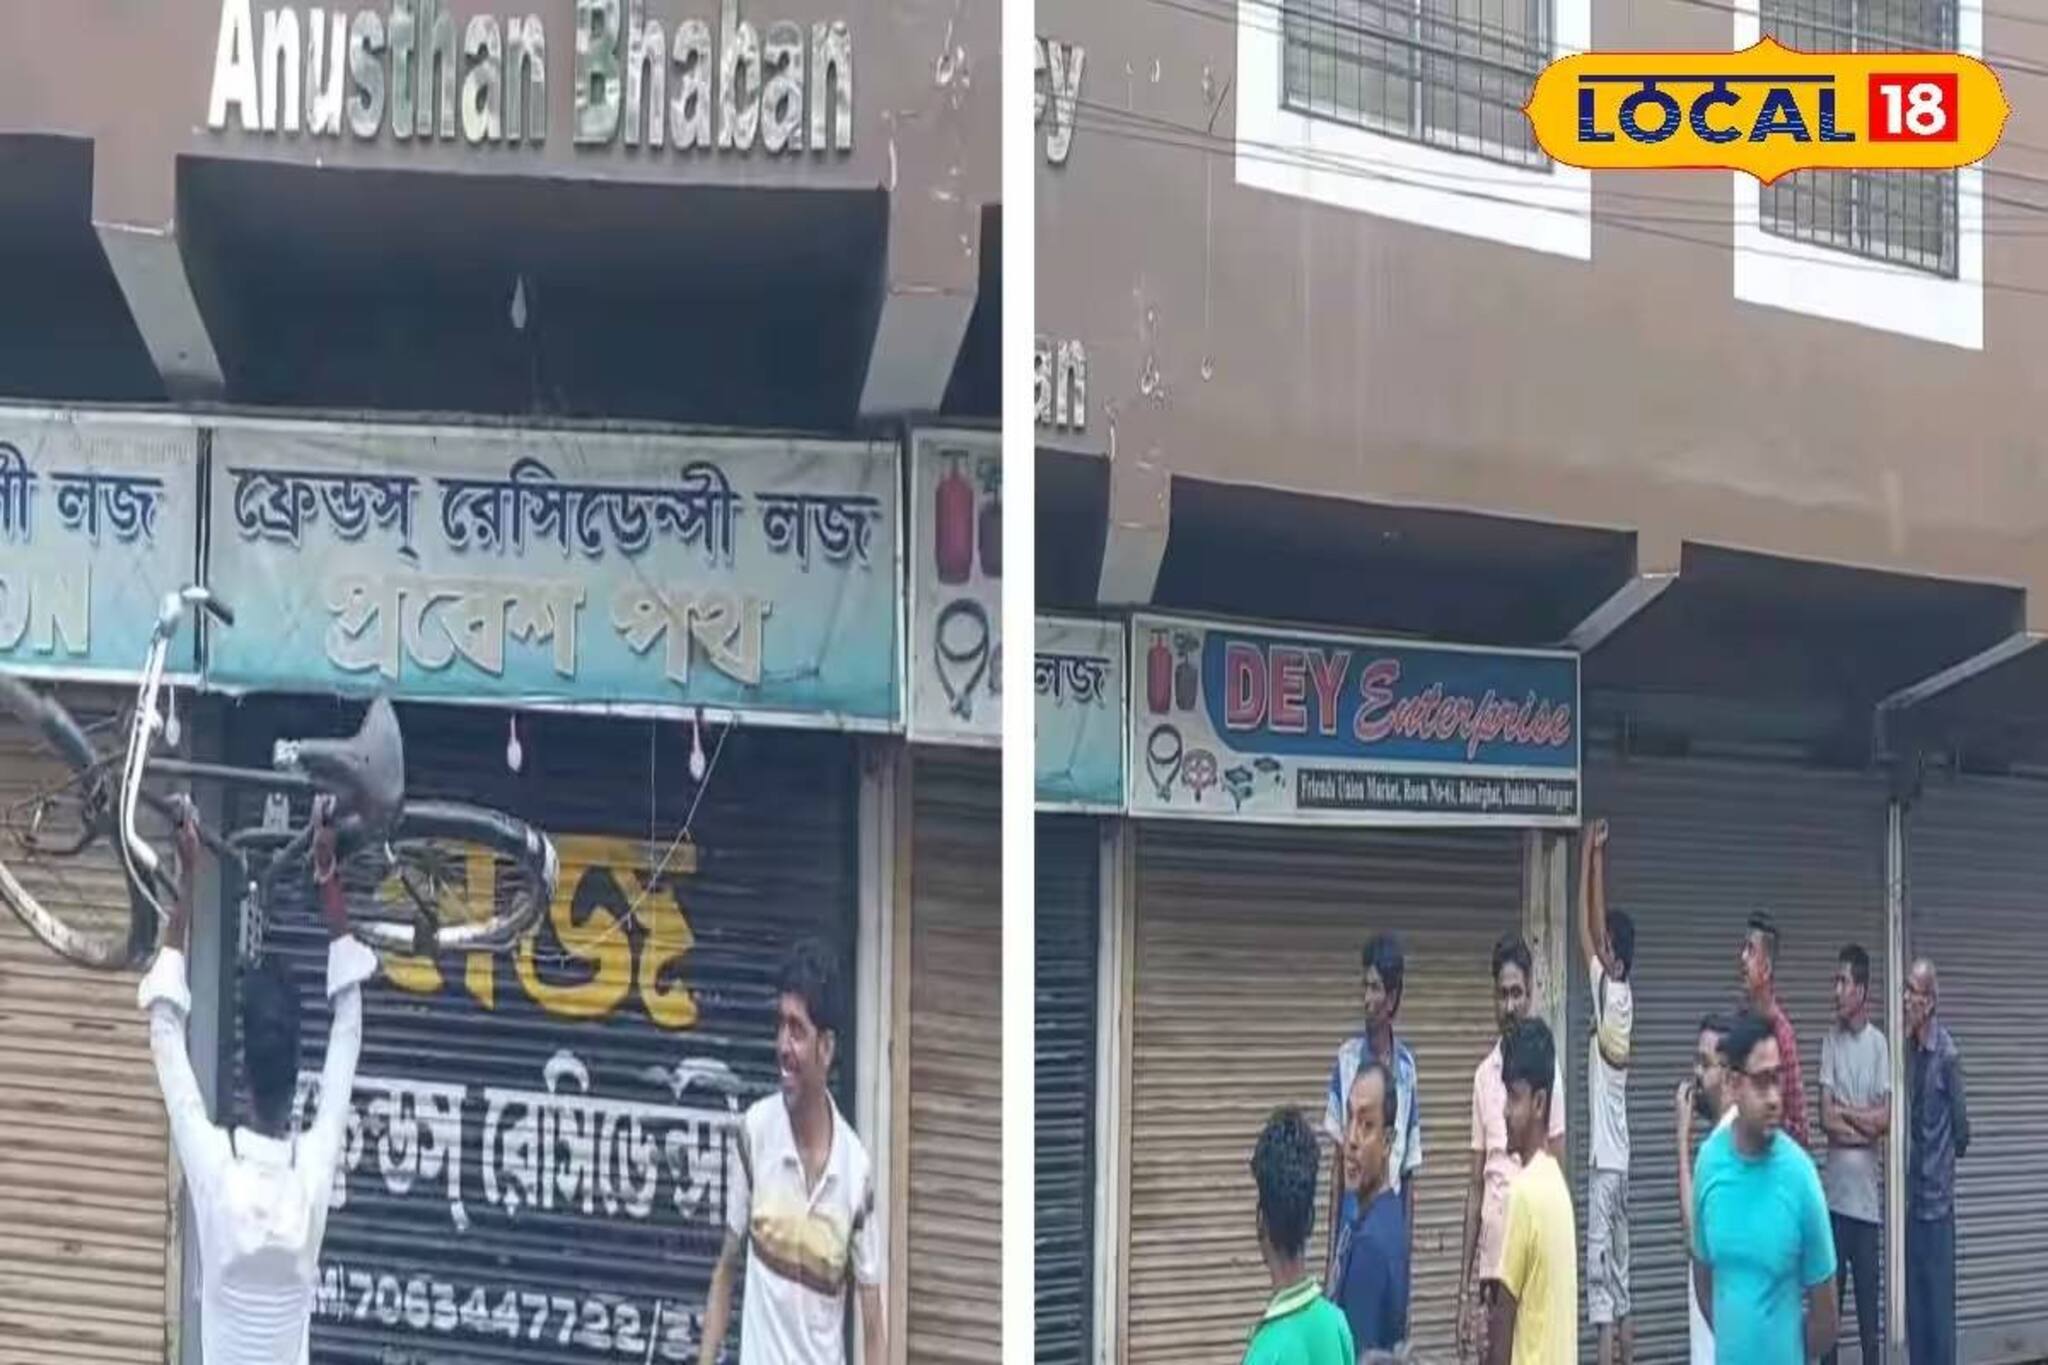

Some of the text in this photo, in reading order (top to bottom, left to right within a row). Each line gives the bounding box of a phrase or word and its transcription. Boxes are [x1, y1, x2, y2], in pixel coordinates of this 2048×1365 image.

[206, 0, 854, 155] Anusthan Bhaban
[48, 471, 165, 546] লজ
[753, 491, 884, 571] লজ
[325, 574, 774, 688] প্রবেশ পথ
[1225, 640, 1572, 761] DEY Enterprise
